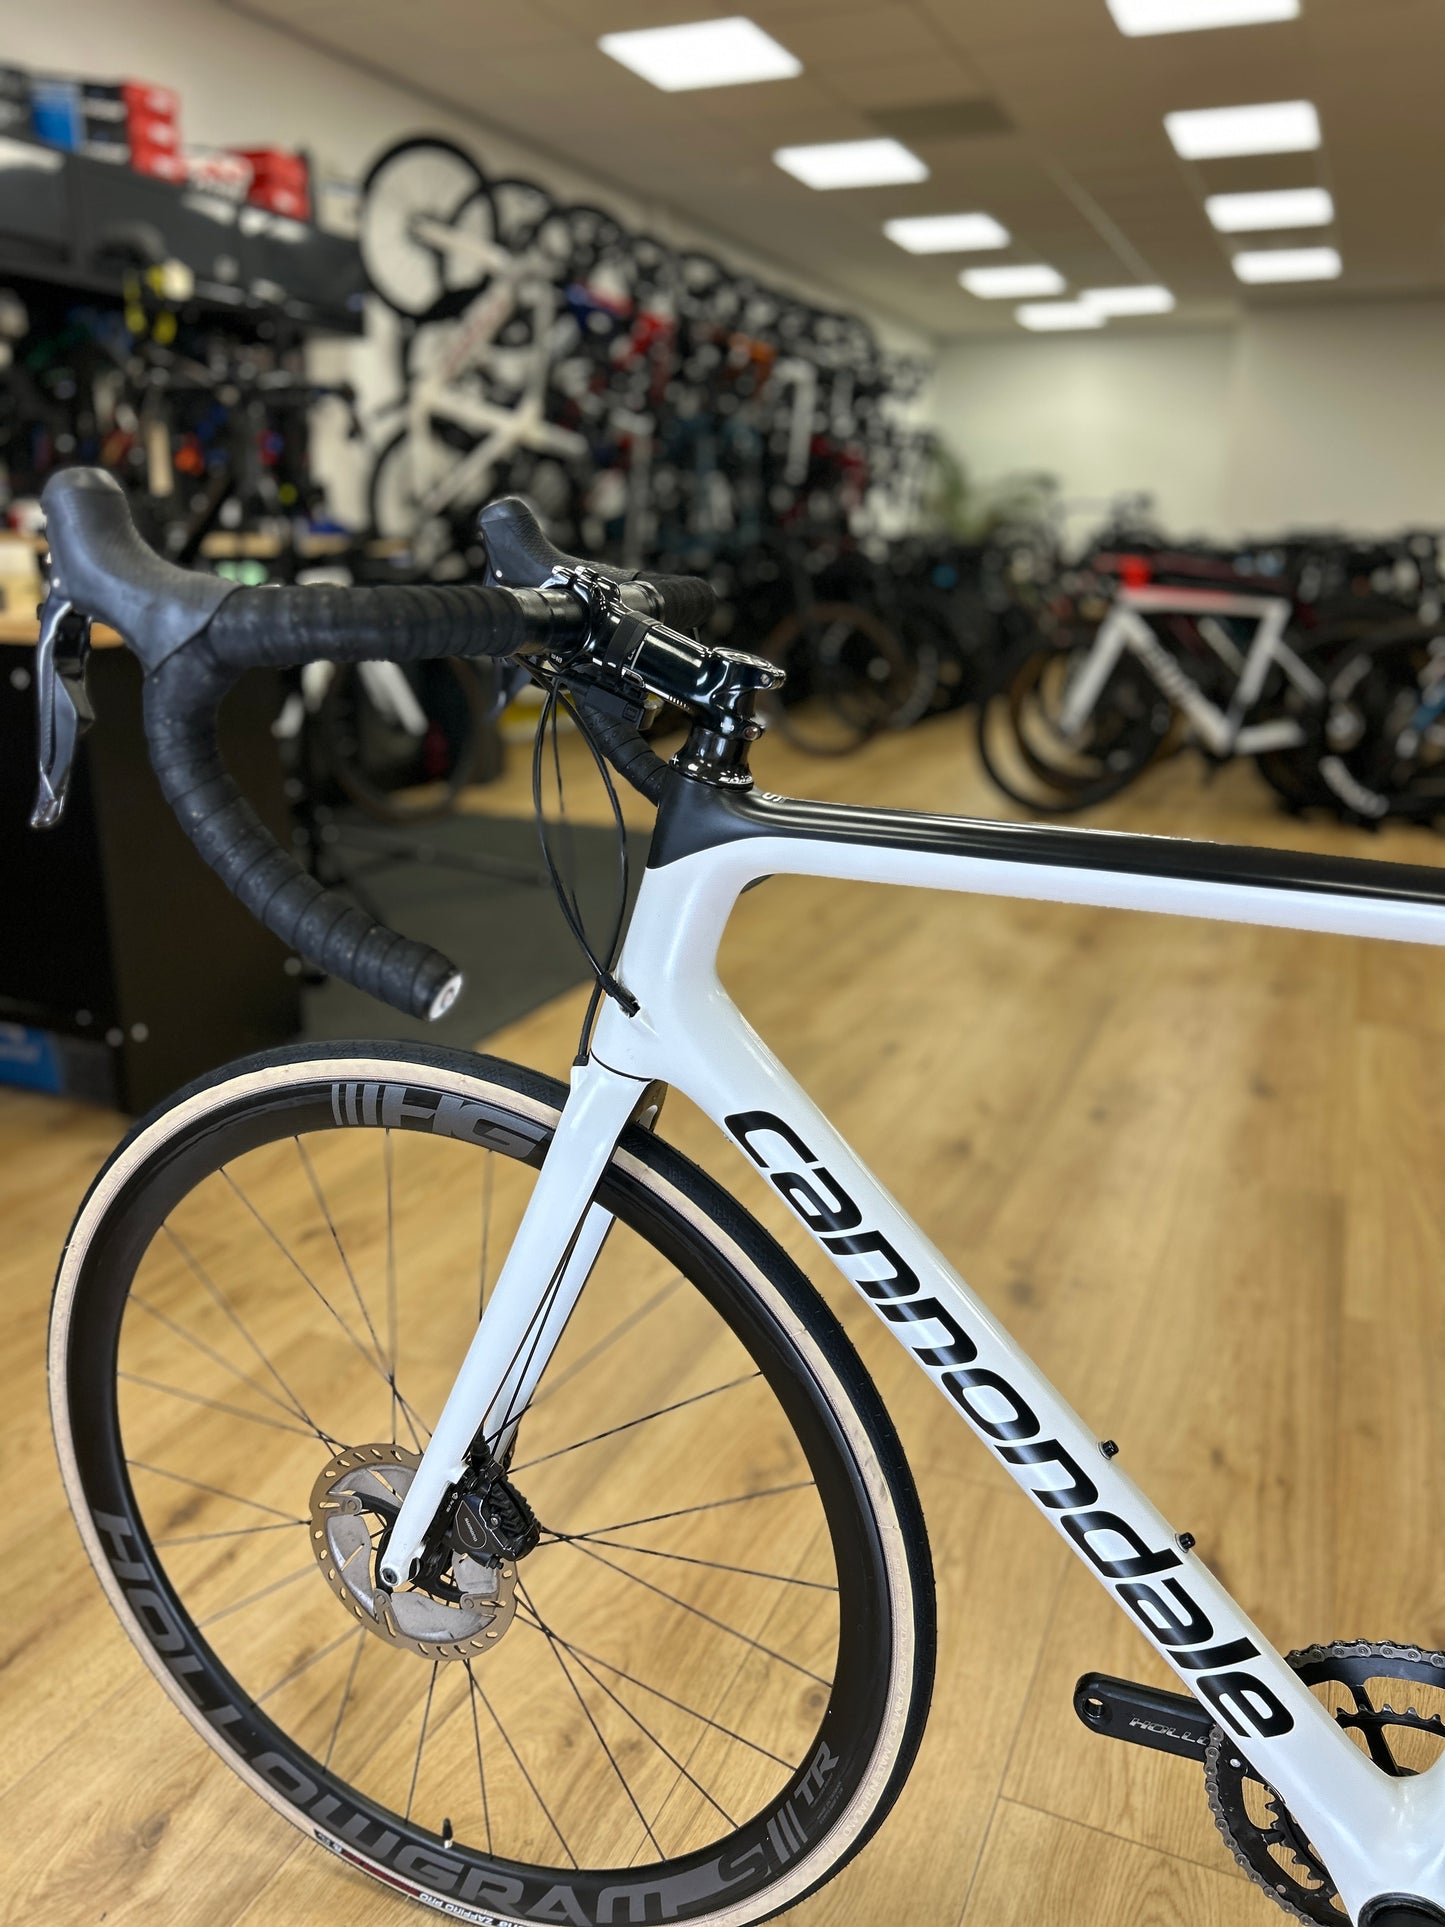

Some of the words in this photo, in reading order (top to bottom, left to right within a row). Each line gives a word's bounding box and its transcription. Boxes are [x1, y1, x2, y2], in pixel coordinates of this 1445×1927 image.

[724, 1110, 1294, 1739] cannondale
[94, 1508, 678, 1926] HOLLOWGRAM
[794, 1741, 839, 1805] TR
[872, 1747, 893, 1780] MADE
[841, 1788, 875, 1838] THAILAND
[419, 1892, 443, 1908] PRO
